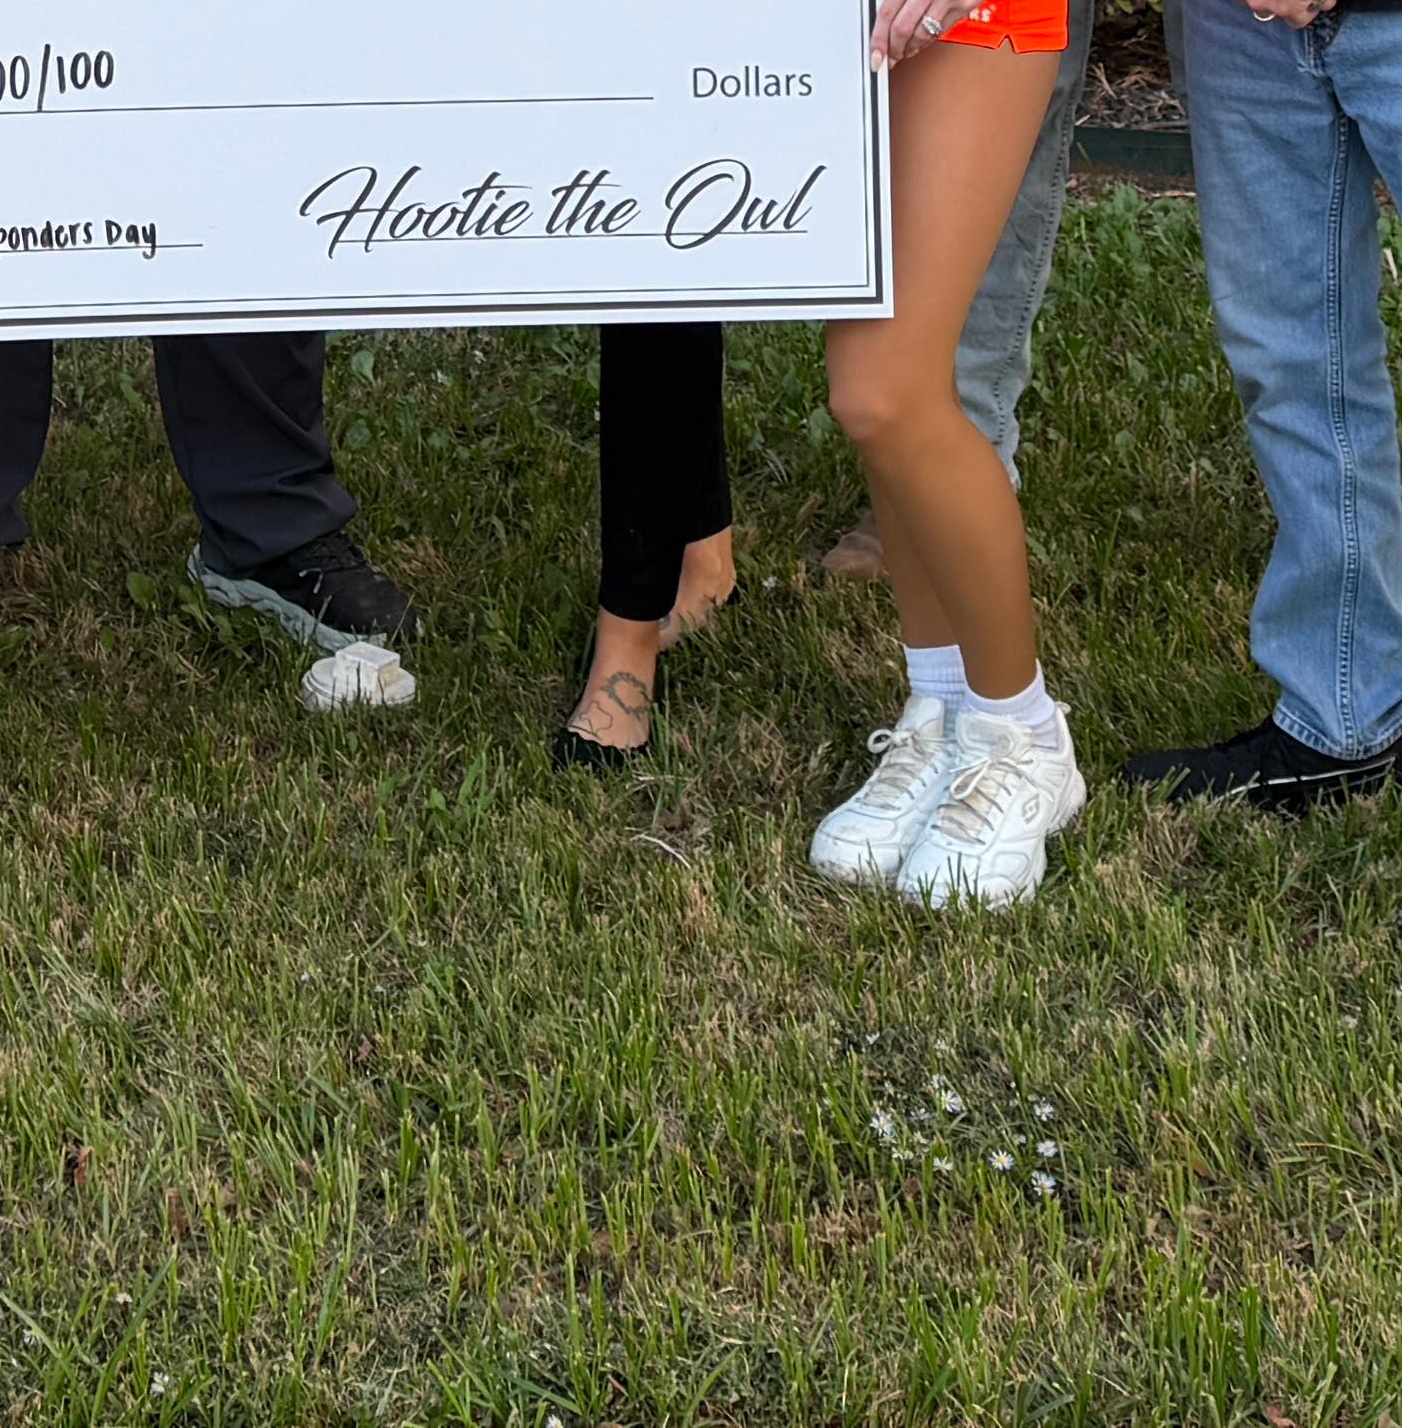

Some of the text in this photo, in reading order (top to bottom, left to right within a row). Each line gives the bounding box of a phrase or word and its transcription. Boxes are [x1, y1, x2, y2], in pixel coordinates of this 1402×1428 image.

[692, 64, 814, 99] Dollars
[299, 158, 828, 259] Hootie the Owl
[106, 219, 158, 259] Day
